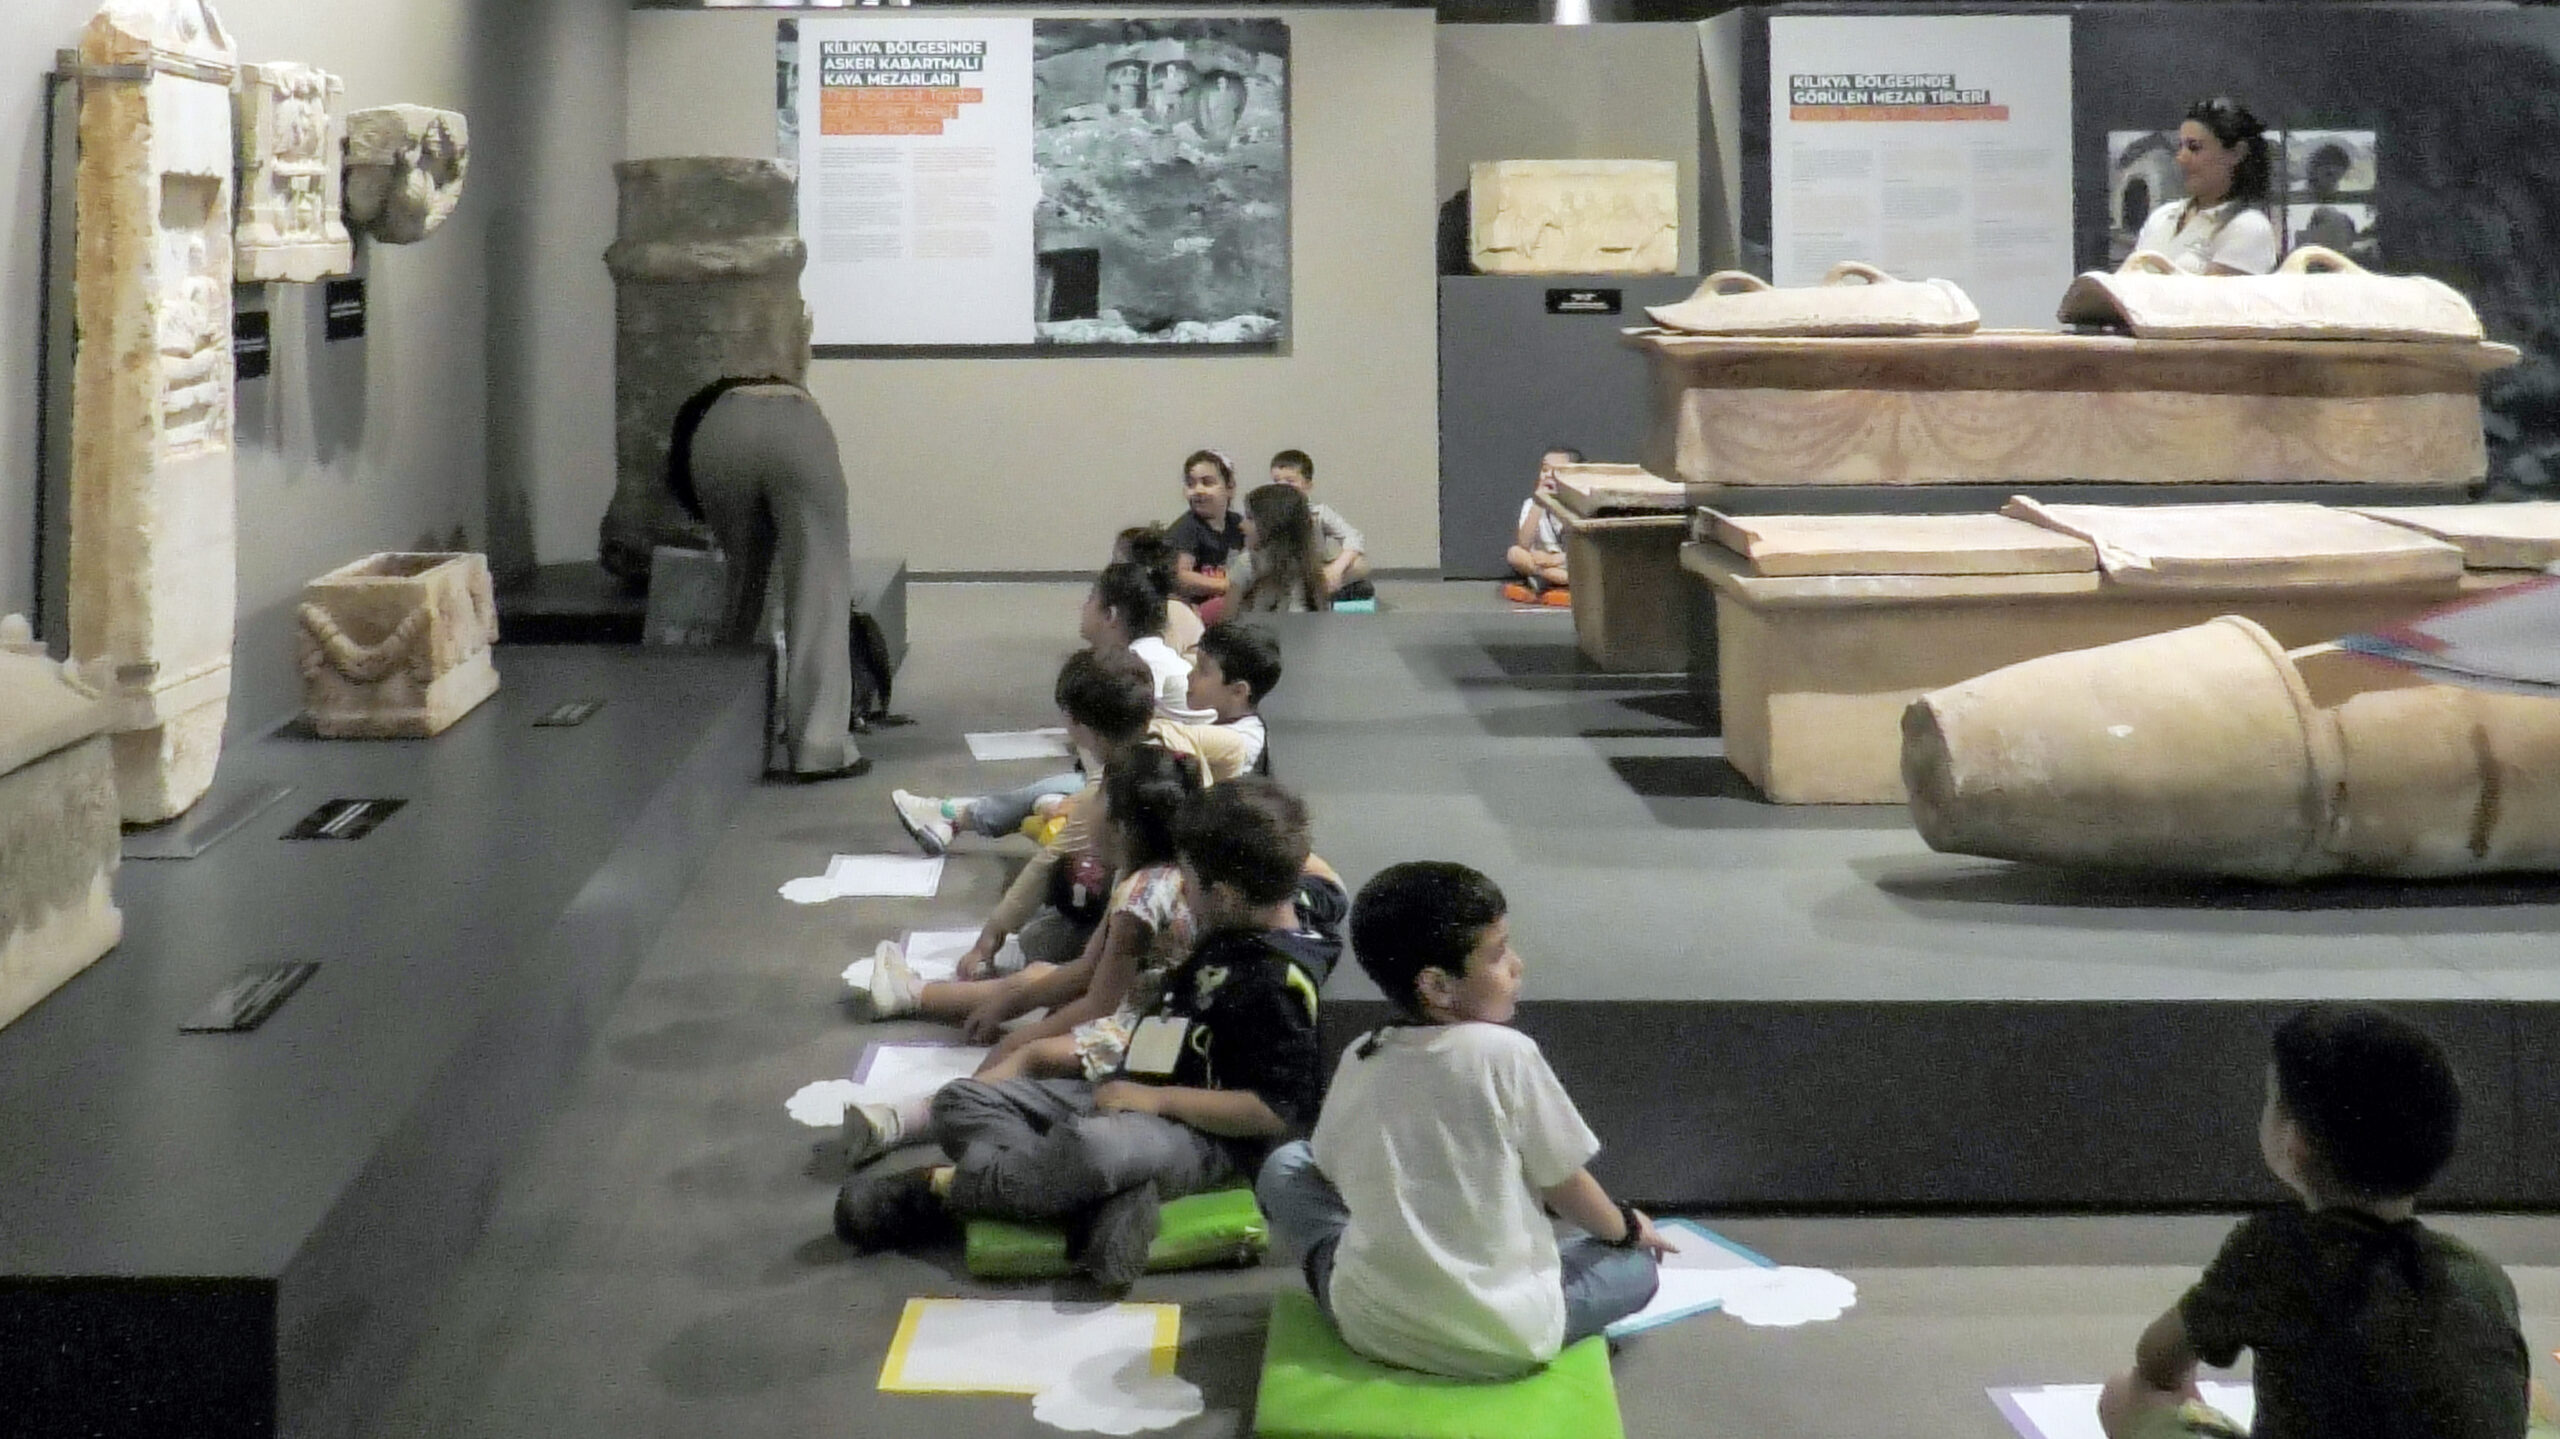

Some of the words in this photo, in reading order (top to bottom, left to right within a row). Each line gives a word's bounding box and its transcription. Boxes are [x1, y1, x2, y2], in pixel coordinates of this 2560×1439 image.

[824, 57, 875, 70] ASKER
[879, 57, 979, 70] KABARTMALI
[824, 72, 862, 86] KAYA
[867, 72, 956, 86] MEZARLARI
[1872, 91, 1925, 104] MEZAR
